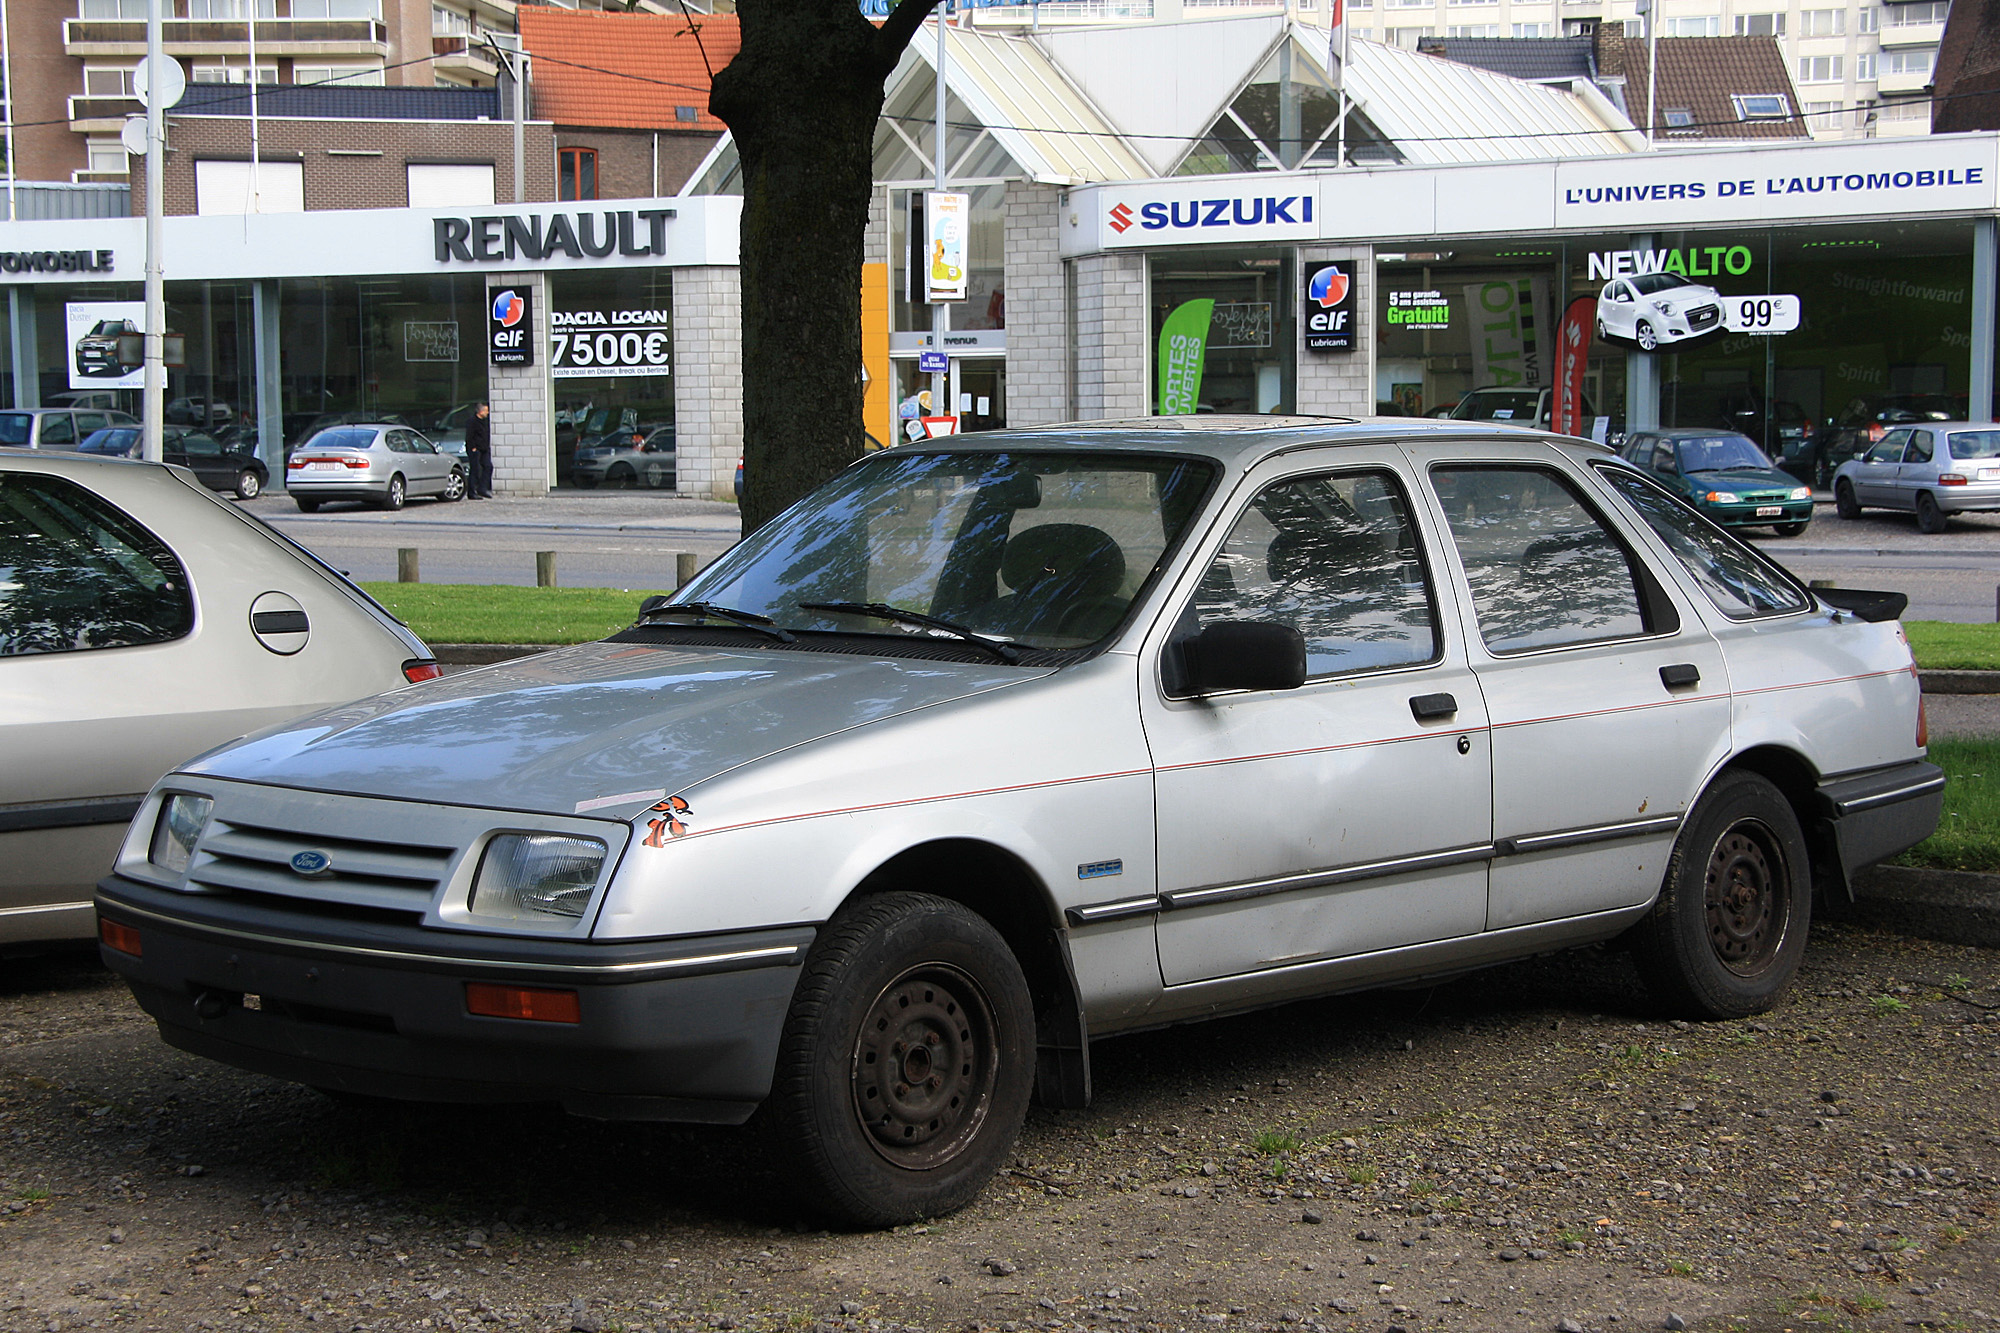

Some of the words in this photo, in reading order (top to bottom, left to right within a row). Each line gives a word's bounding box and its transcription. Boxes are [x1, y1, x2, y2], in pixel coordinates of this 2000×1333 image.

[1566, 183, 1706, 204] L'UNIVERS
[1717, 180, 1756, 198] DE
[1766, 167, 1984, 195] L'AUTOMOBILE
[1141, 196, 1313, 230] SUZUKI
[431, 209, 677, 262] RENAULT
[0, 250, 114, 273] OMOBILE
[1389, 291, 1399, 306] 5
[1832, 271, 1965, 304] Straightforward
[551, 312, 608, 326] DACIA
[611, 310, 668, 325] LOGAN
[1310, 310, 1349, 331] elf
[1387, 306, 1449, 324] Gratuit!
[494, 330, 525, 347] elf
[550, 332, 669, 366] 7500€
[926, 335, 978, 345] Bnvenue
[1310, 338, 1348, 347] Lubricants
[495, 353, 525, 362] Lubricants
[1164, 334, 1187, 414] ORTES
[1179, 337, 1202, 414] UVERTES
[1836, 361, 1882, 384] Spirit
[296, 852, 321, 868] Ford
